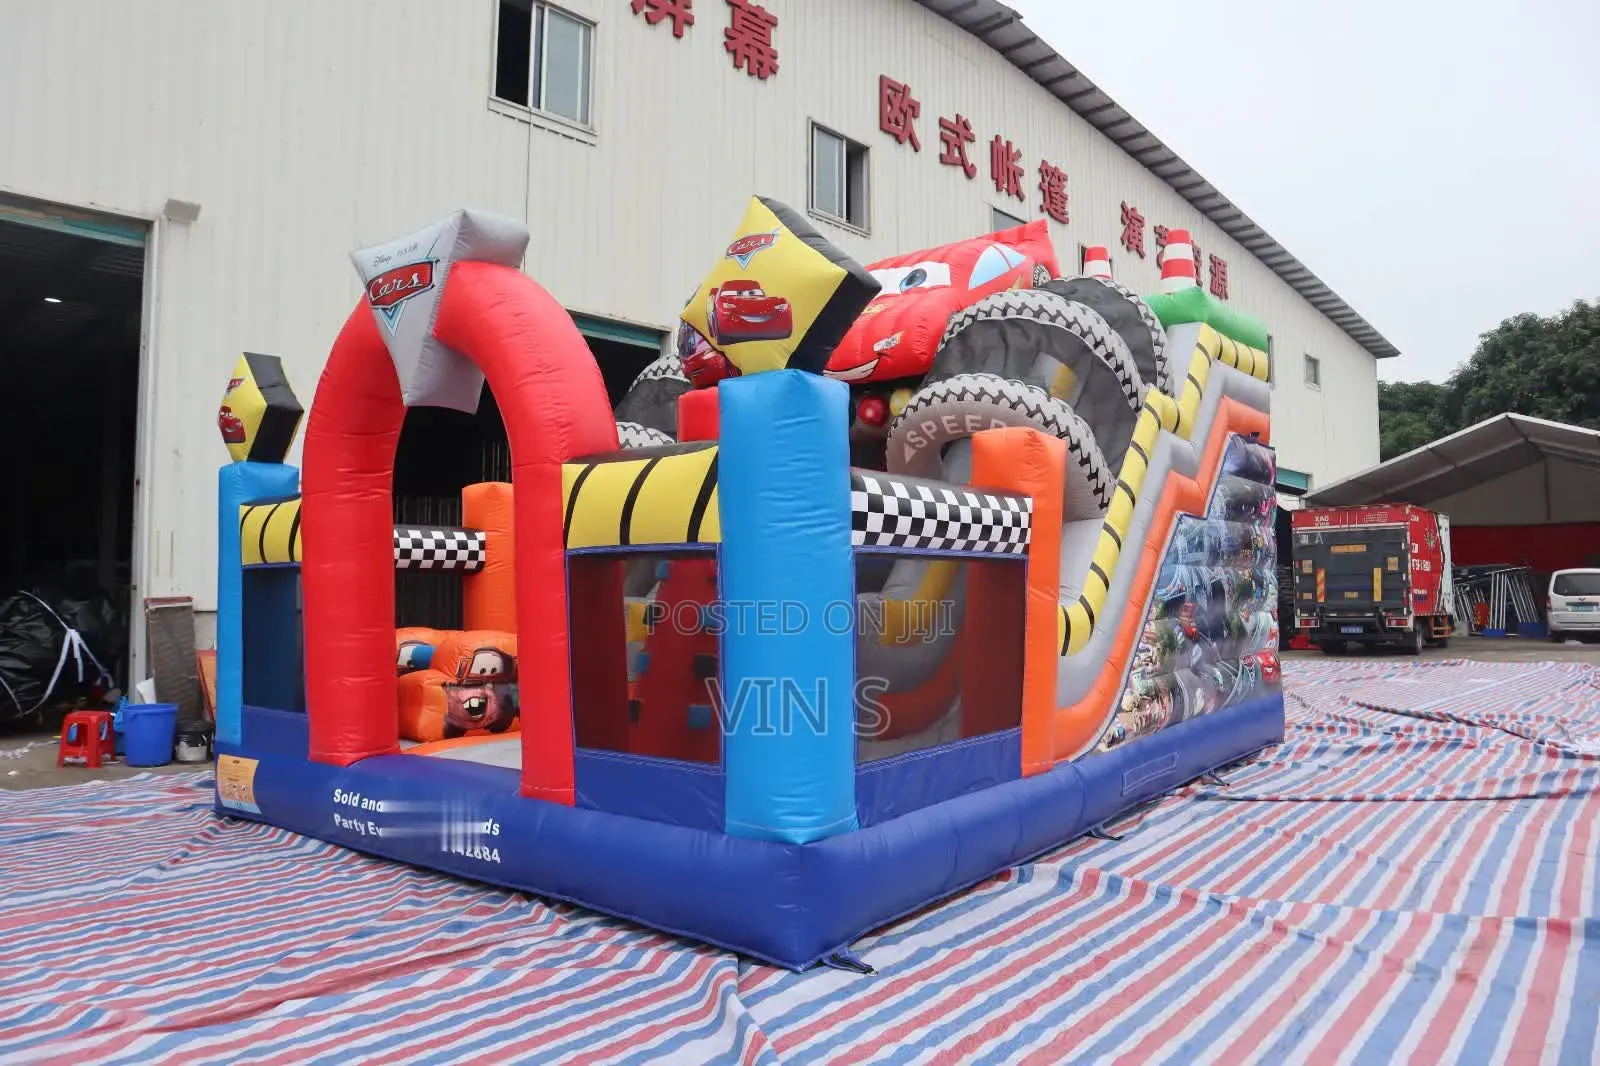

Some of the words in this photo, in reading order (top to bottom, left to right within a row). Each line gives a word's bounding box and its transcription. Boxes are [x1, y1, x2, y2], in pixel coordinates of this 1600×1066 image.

[879, 74, 1069, 224] 欧式帐篷
[727, 236, 771, 254] Cars
[368, 272, 424, 301] Cars
[333, 788, 360, 807] Sold
[333, 812, 366, 836] Party
